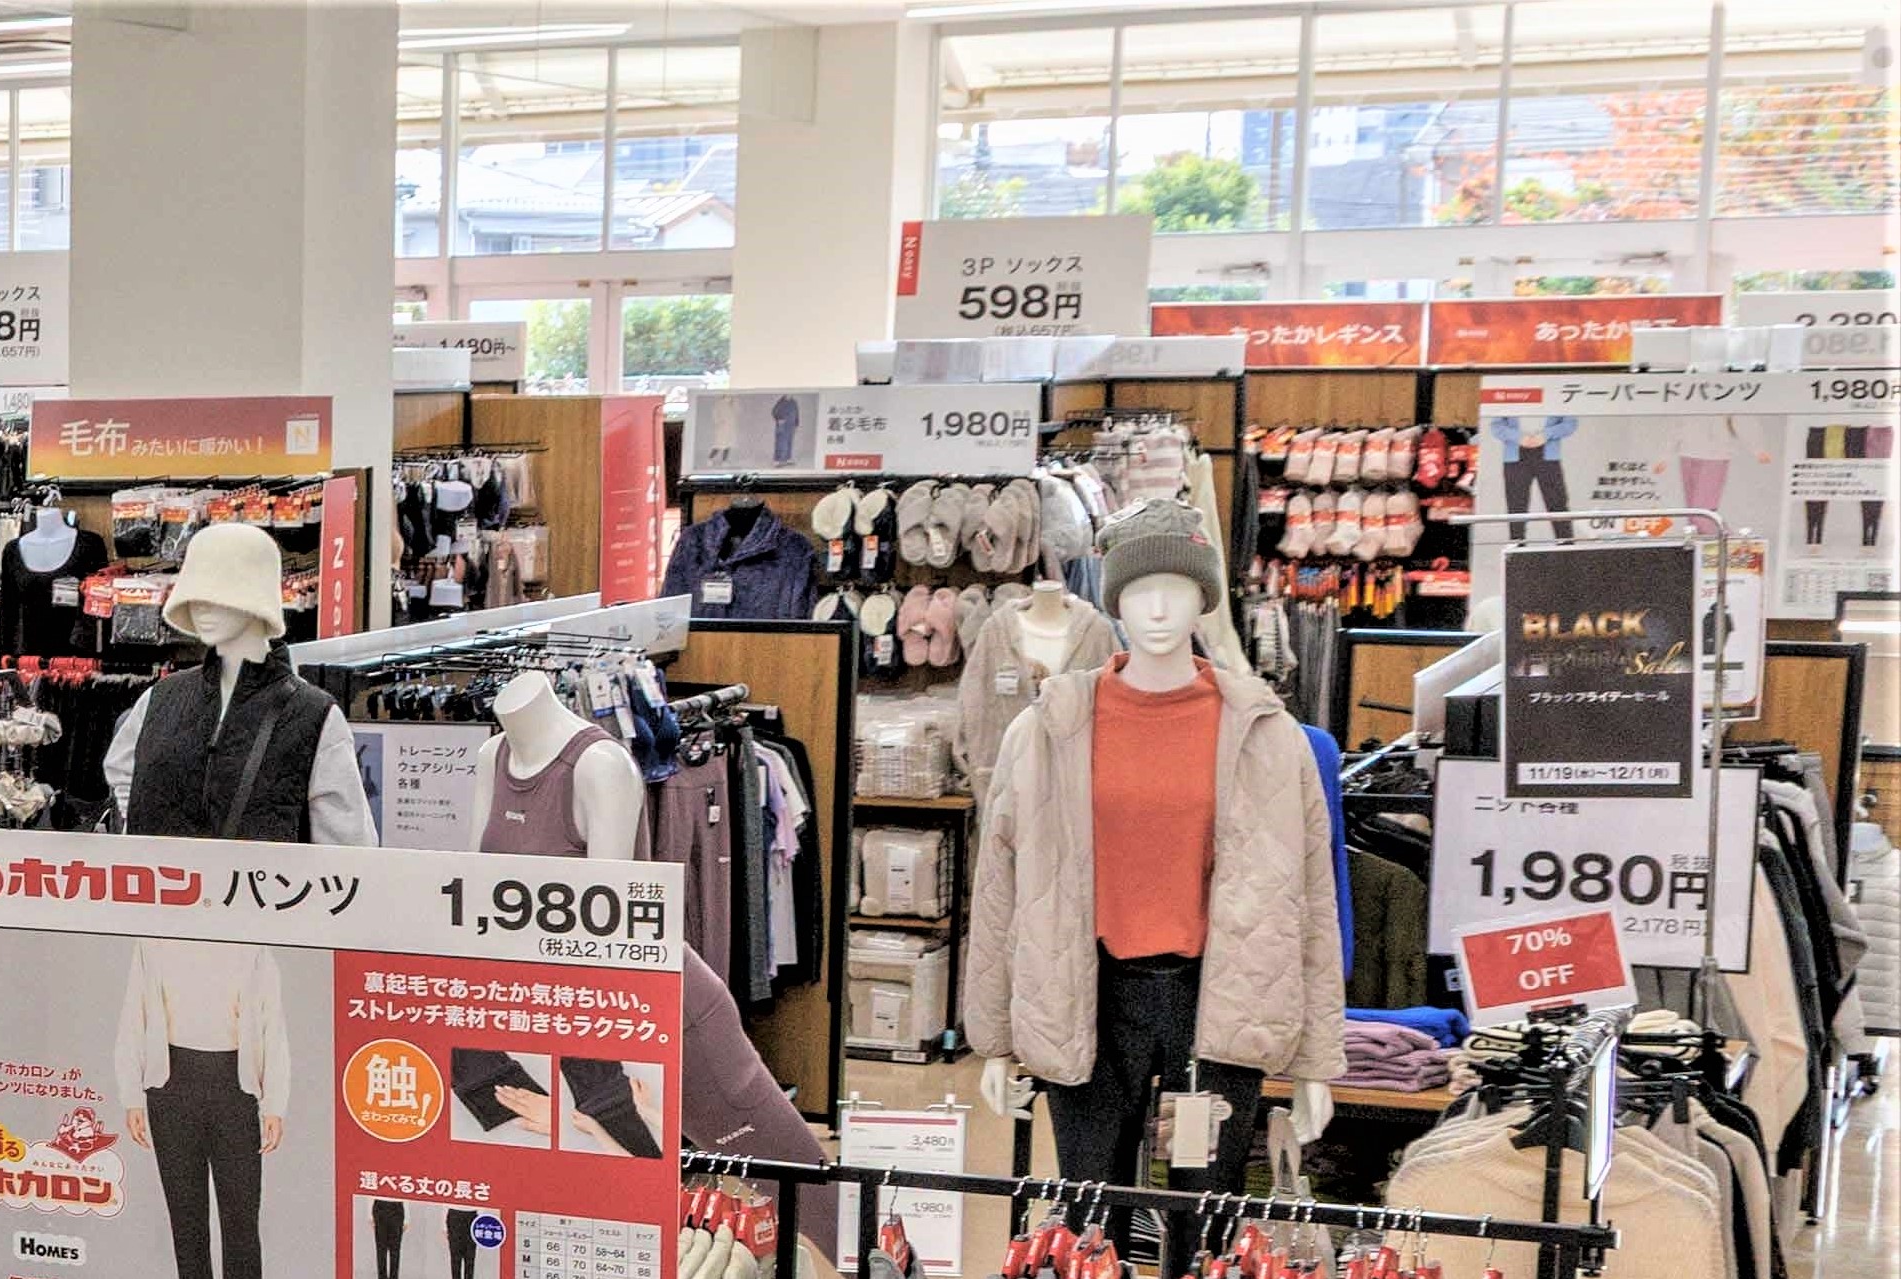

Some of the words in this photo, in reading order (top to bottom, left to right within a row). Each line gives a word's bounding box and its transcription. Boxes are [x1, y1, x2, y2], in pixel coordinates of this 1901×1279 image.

[962, 258, 994, 276] 3P
[1007, 256, 1083, 275] ソックス
[959, 284, 1083, 320] 598円
[59, 418, 130, 457] 毛布
[827, 416, 888, 432] 着る毛布
[922, 412, 1031, 440] 1,980円
[1522, 608, 1650, 641] BLACK
[1528, 691, 1670, 704] ブラックフライデーセール
[399, 746, 468, 758] トレーニング
[397, 762, 477, 776] ウェアシリーズ
[398, 777, 421, 790] 各種
[222, 869, 360, 915] パンツ
[627, 882, 665, 900] 税抜
[1470, 850, 1709, 911] 1,980円
[441, 878, 665, 941] 1,980円
[538, 937, 668, 964] (税込2,178円)
[1507, 927, 1572, 955] 70%
[1519, 964, 1575, 991] OFF
[364, 972, 650, 1013] 裏起毛であったか気持ちいい。
[348, 999, 669, 1044] ストレッチ素材で動きもラクラク。
[366, 1054, 418, 1109] 触
[359, 1171, 492, 1201] 選べる丈の長さ
